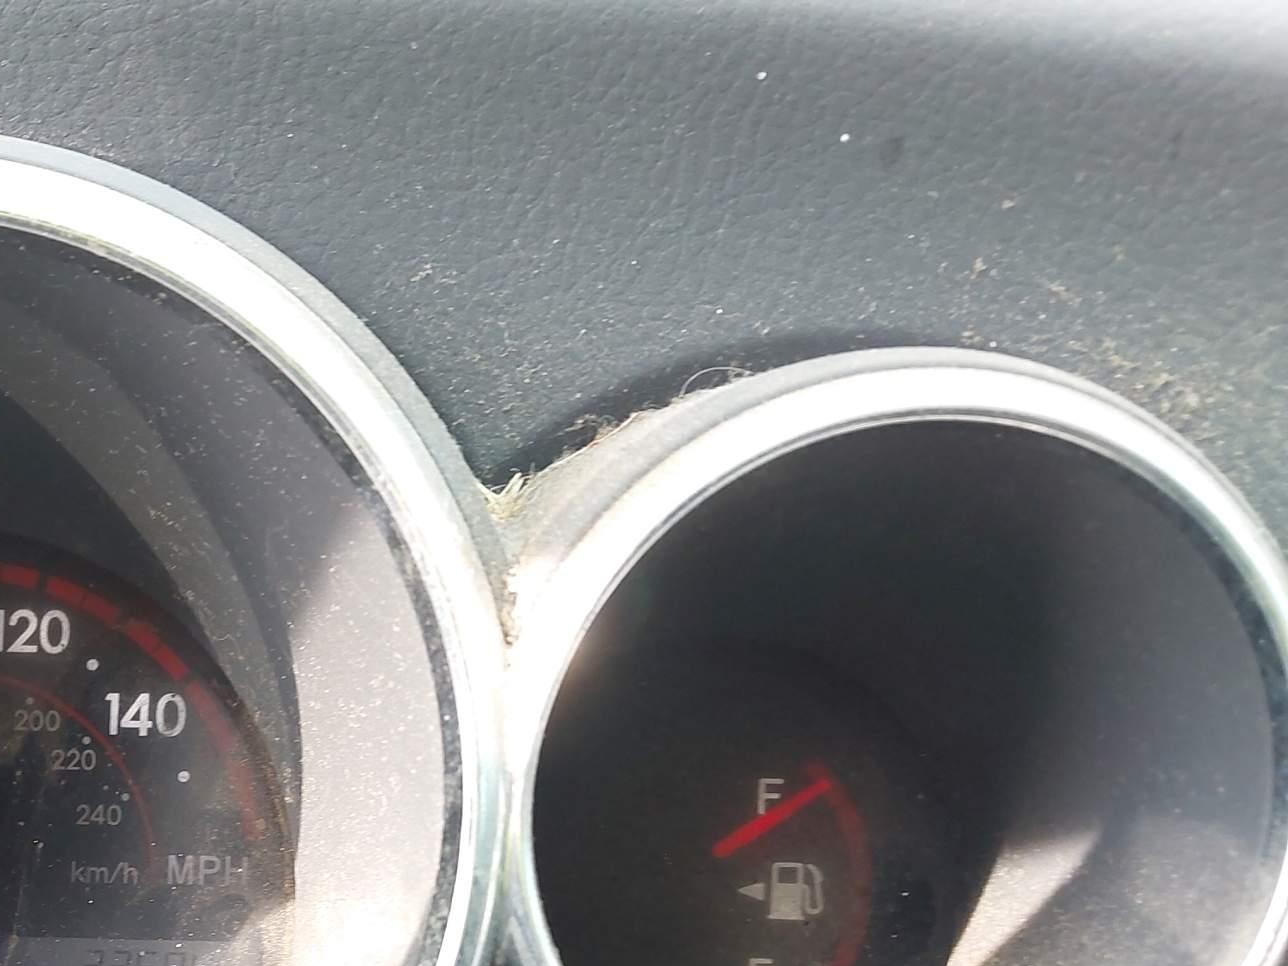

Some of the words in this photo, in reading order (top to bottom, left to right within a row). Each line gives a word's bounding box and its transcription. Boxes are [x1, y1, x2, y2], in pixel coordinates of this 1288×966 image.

[15, 710, 60, 731] 200
[105, 693, 187, 737] 140
[52, 750, 96, 770] 220
[758, 778, 785, 815] F
[76, 804, 121, 826] 240
[71, 861, 139, 885] km/h
[167, 854, 247, 885] MPH
